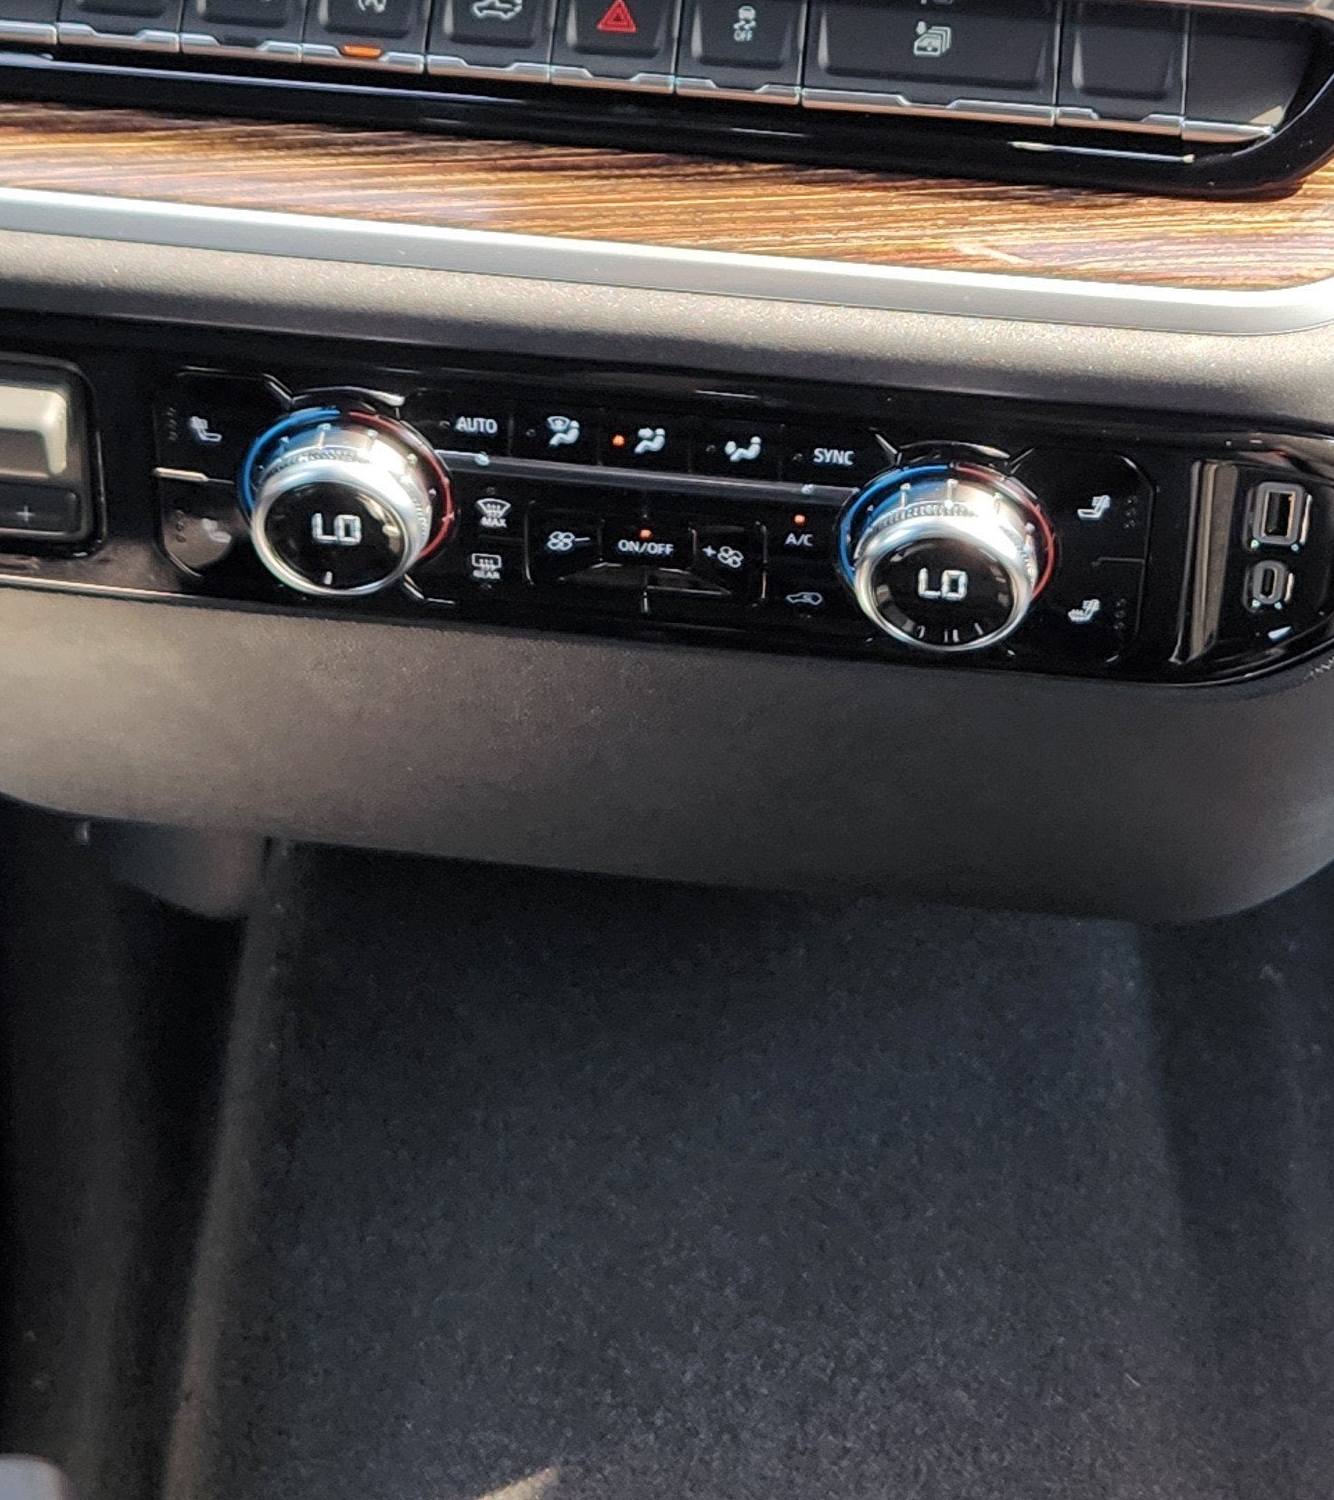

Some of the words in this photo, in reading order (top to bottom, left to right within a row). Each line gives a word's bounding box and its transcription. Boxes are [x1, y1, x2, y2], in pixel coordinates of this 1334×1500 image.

[455, 415, 498, 434] AUTO
[813, 447, 855, 466] SYNC
[617, 538, 675, 556] ON/OFF
[784, 532, 814, 547] A/C
